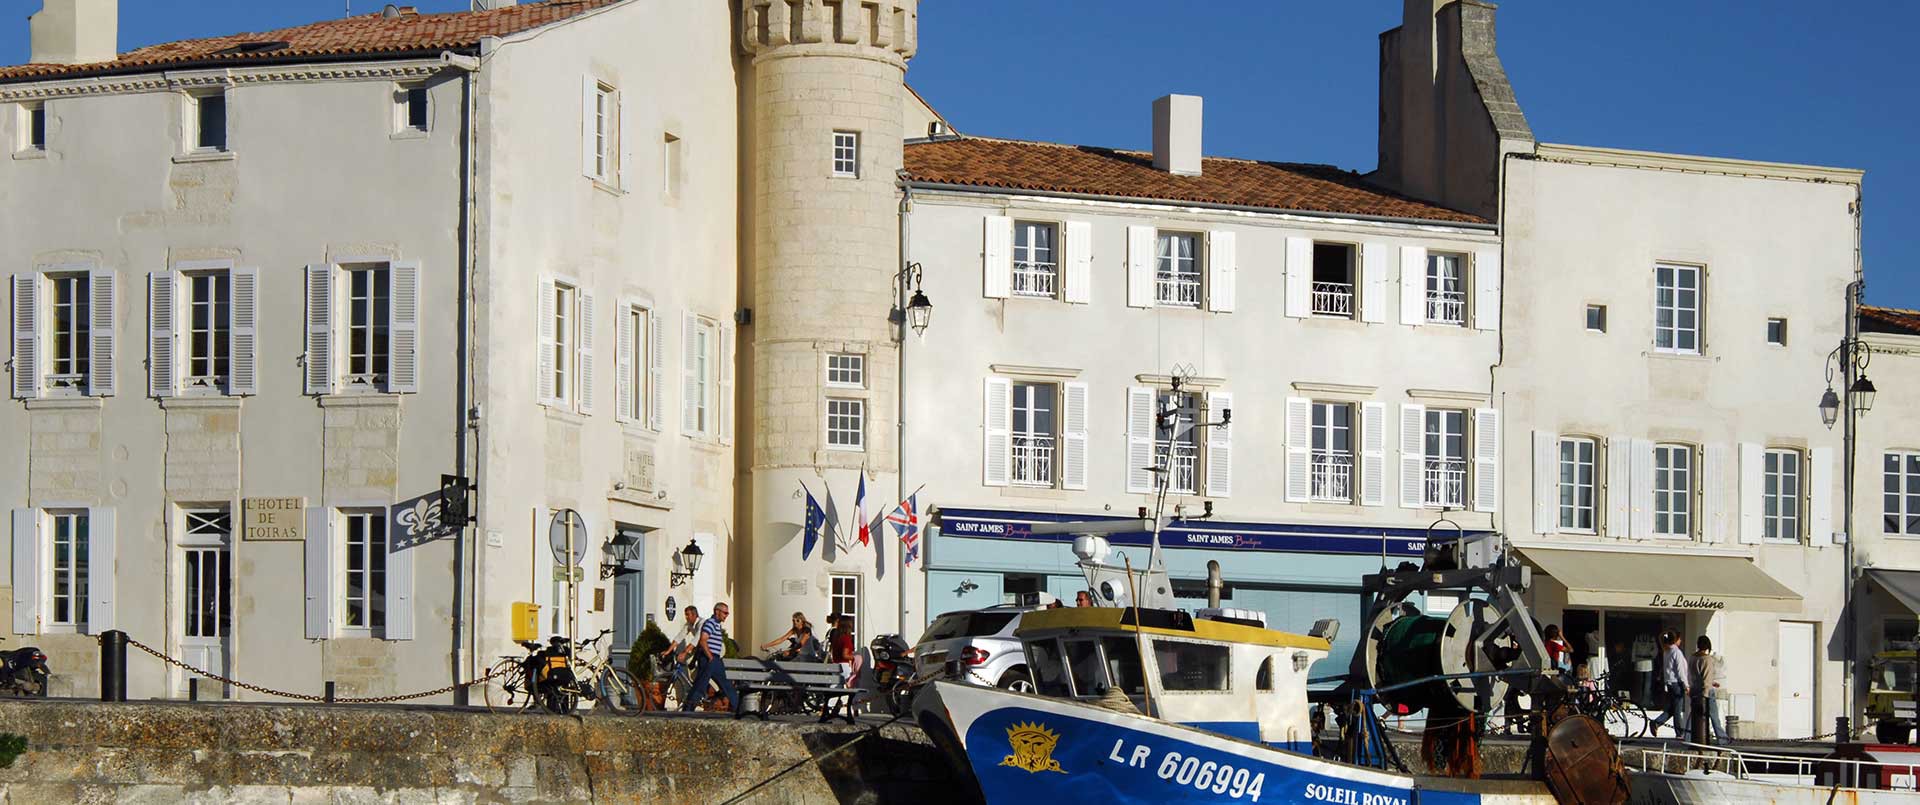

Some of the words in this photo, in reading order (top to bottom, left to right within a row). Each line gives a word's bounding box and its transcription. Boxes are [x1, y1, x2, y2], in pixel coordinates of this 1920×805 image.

[247, 498, 302, 510] L'HOTEL
[258, 512, 276, 524] DE
[248, 526, 297, 538] TOIRAS
[955, 522, 979, 532] SAINT
[980, 523, 1004, 533] JAMES
[1187, 534, 1209, 543] SAINT
[1210, 535, 1233, 544] JAMES
[1649, 593, 1668, 607] La
[1672, 594, 1725, 610] Loubine
[1157, 751, 1265, 803] 606994
[1304, 783, 1359, 805] SOLEIL
